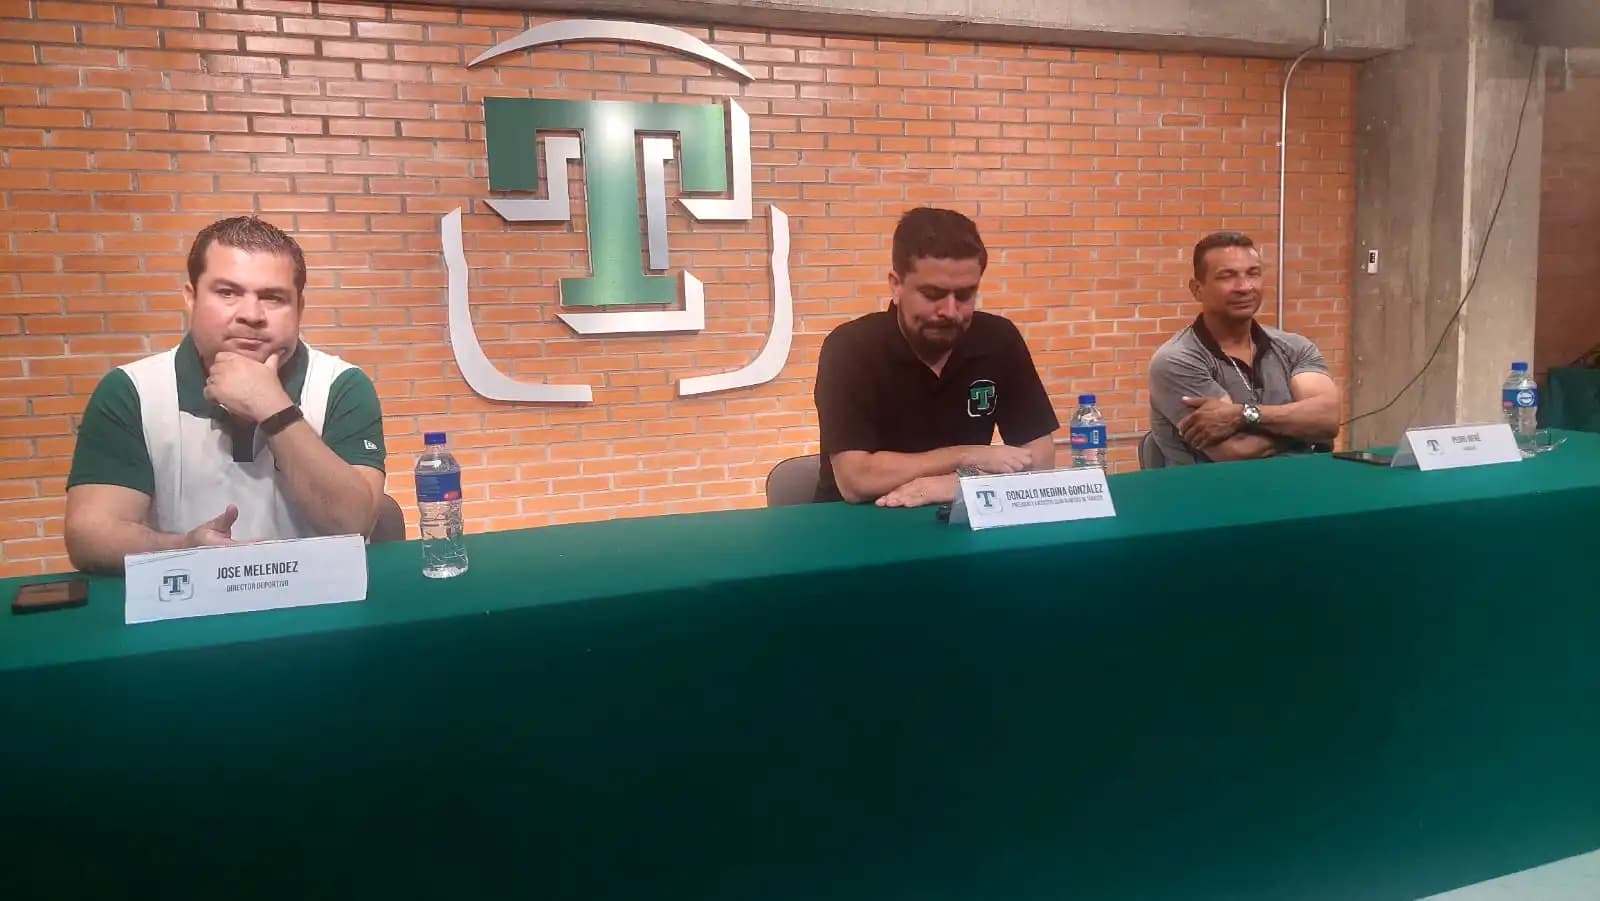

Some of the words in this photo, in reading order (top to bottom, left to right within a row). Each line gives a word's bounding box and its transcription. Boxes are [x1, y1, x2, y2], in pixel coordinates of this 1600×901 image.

[484, 97, 728, 307] T
[970, 386, 994, 410] T
[1426, 439, 1440, 451] T
[976, 490, 995, 508] T
[1006, 489, 1038, 501] GONZALO
[1040, 486, 1067, 498] MEDINA
[1068, 483, 1104, 496] GONZÁLEZ
[217, 566, 241, 580] JOSE
[244, 560, 299, 577] MELENDEZ
[163, 574, 190, 594] T
[226, 582, 256, 592] DIRECTOR
[257, 579, 289, 590] DEPORTIVO
